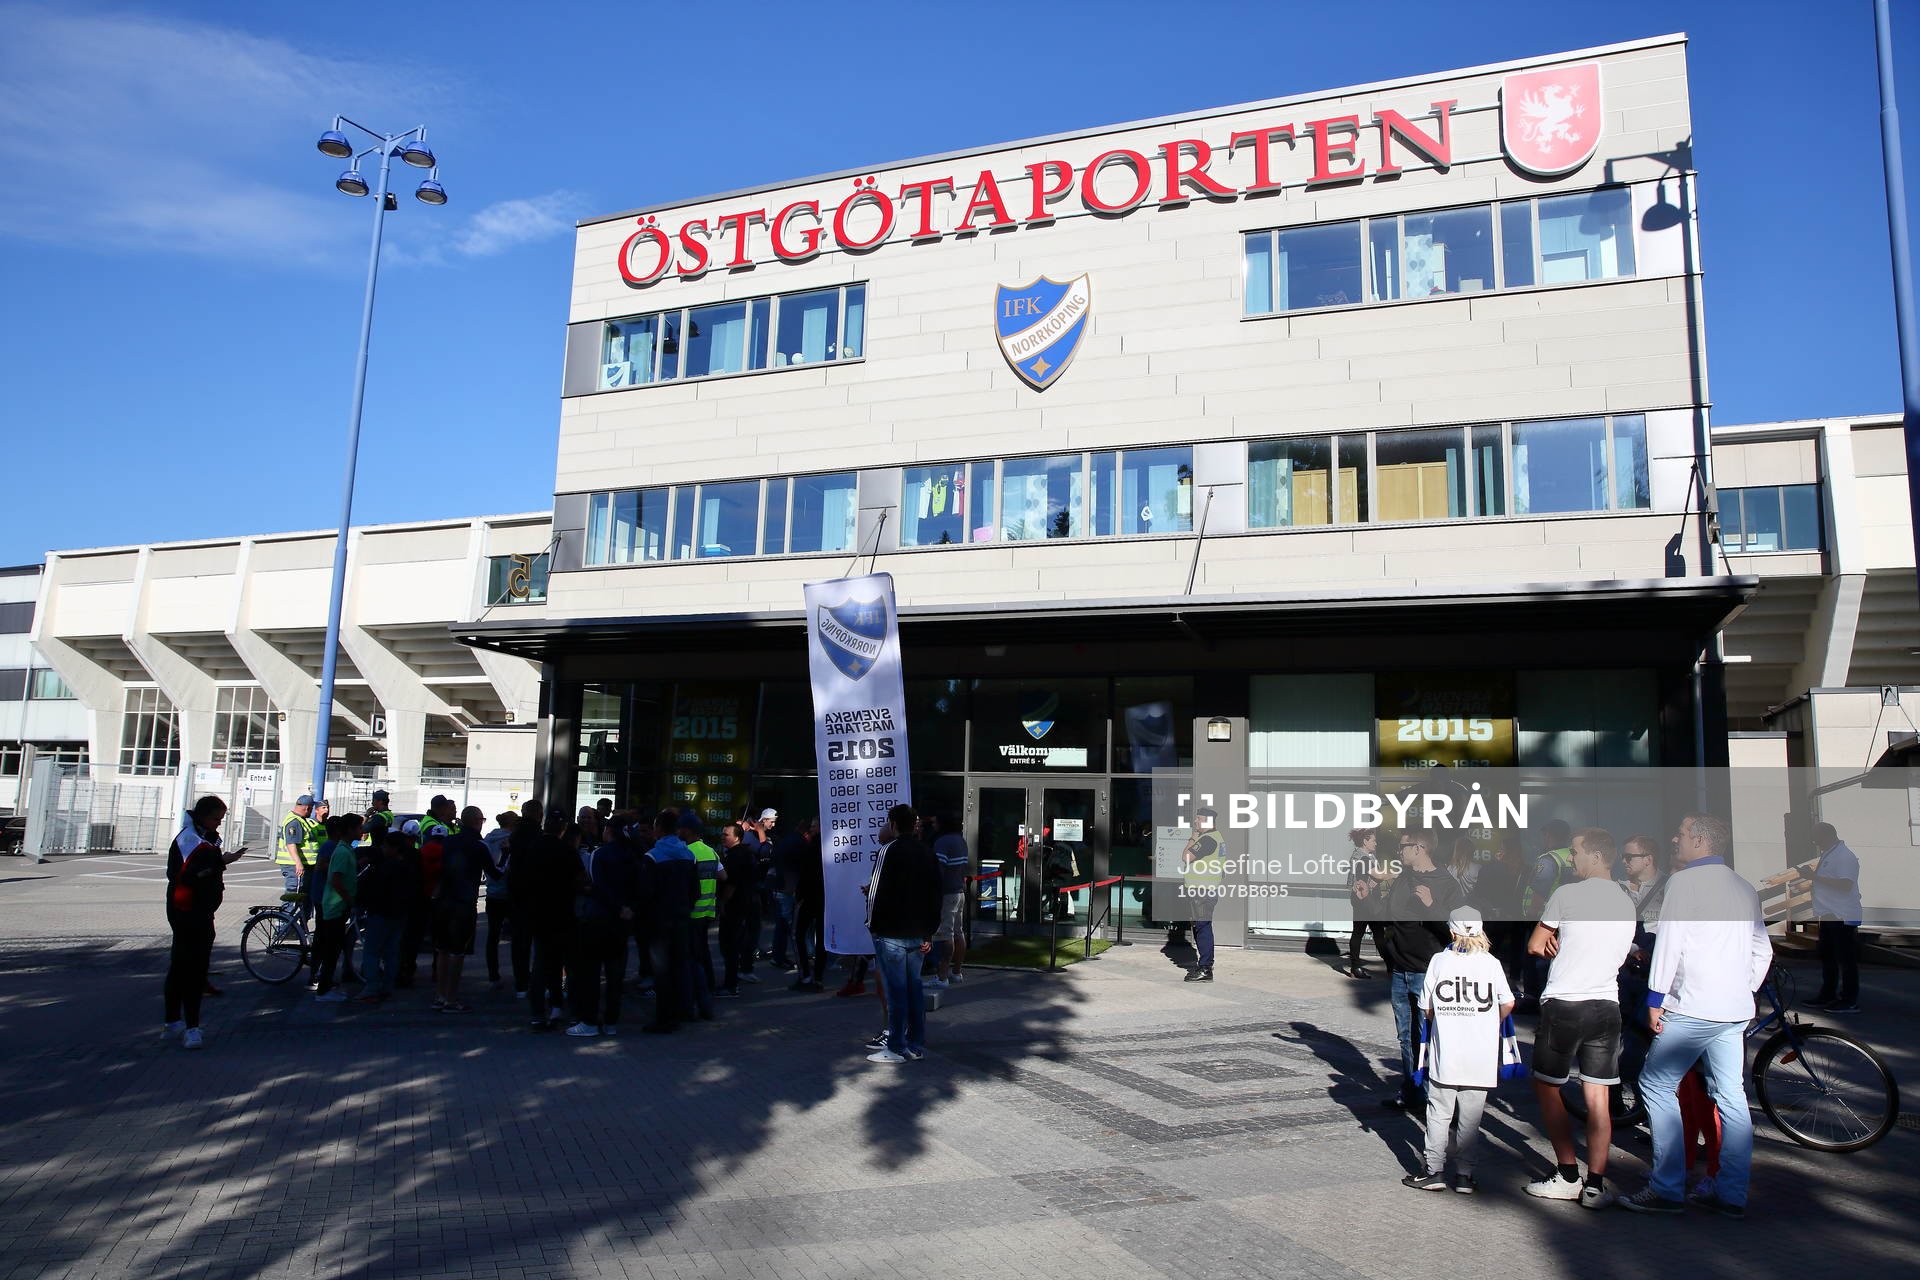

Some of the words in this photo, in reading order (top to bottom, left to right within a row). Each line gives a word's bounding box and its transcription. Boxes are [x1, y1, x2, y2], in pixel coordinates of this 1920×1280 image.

[617, 98, 1458, 286] ÖSTGÖTAPORTEN
[1003, 296, 1042, 318] IFK
[1010, 294, 1086, 356] NORRKÖPING
[375, 718, 386, 734] D
[671, 717, 737, 739] 2015
[1397, 715, 1494, 742] 2015
[1435, 976, 1494, 1013] city
